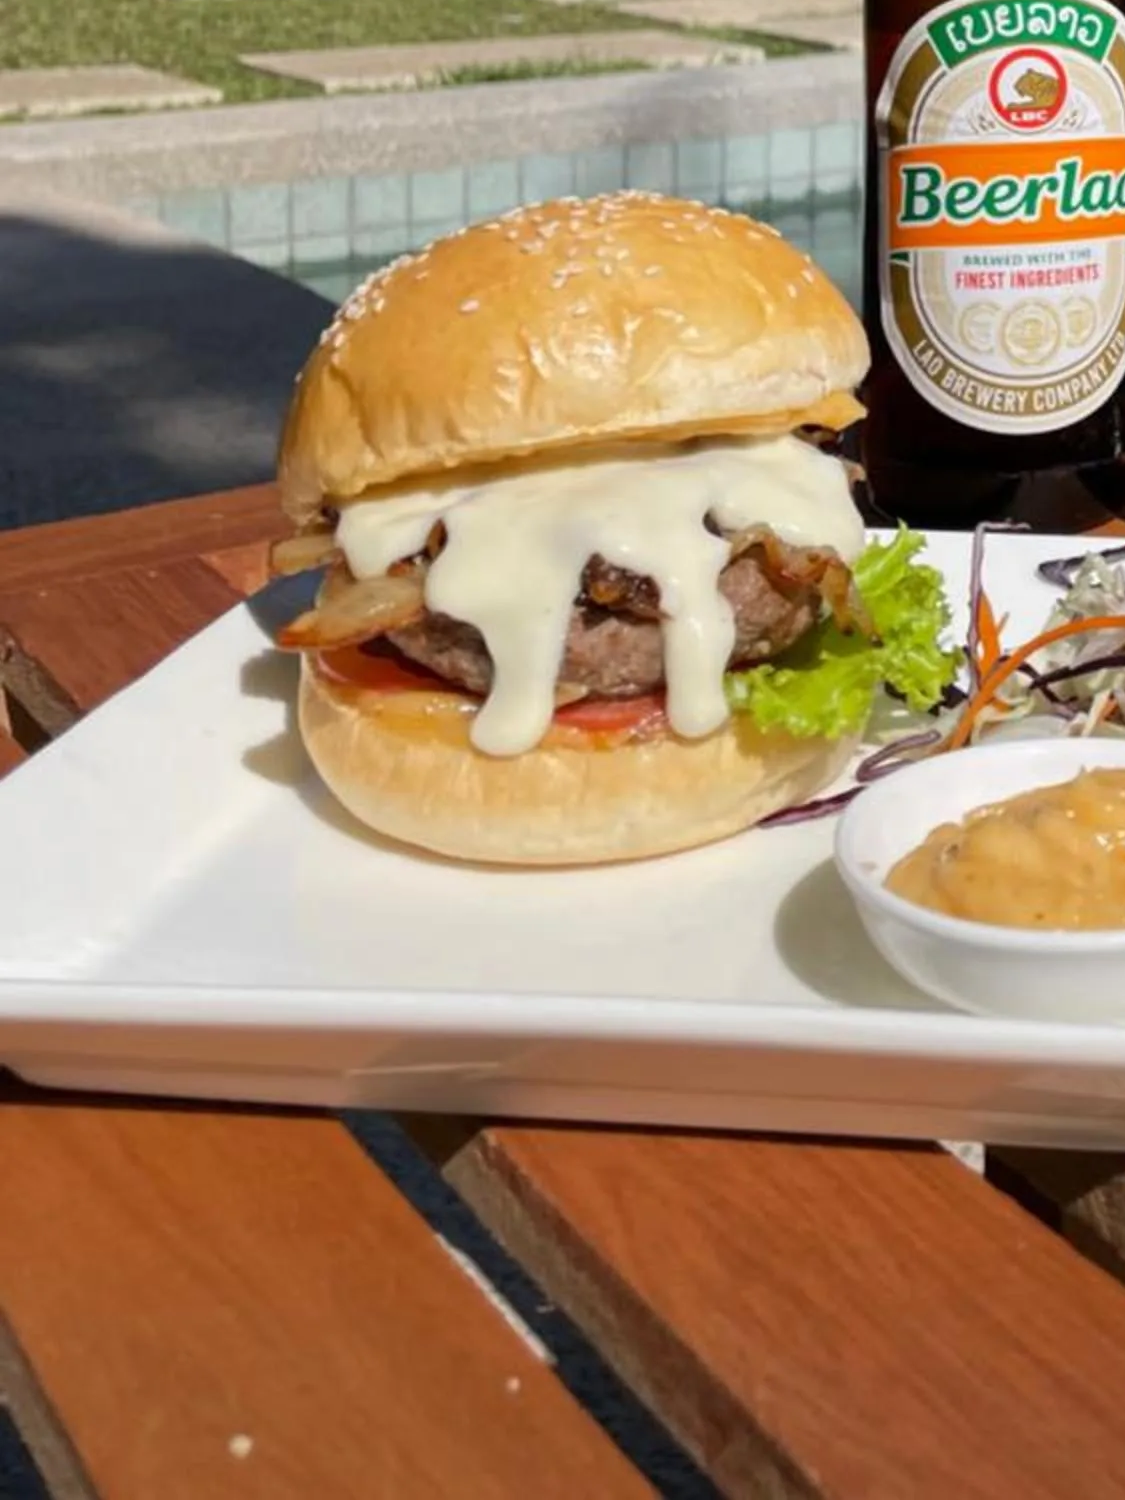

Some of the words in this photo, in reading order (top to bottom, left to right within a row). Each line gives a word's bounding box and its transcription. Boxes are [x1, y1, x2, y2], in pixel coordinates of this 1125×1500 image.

[963, 254, 1023, 266] BREWED
[1027, 252, 1065, 265] WITH
[955, 270, 1006, 290] FINEST
[1010, 263, 1099, 289] INGREDIENTS
[912, 339, 944, 377] LAO
[941, 367, 1029, 412] BREWERY
[1033, 357, 1109, 412] COMPANY
